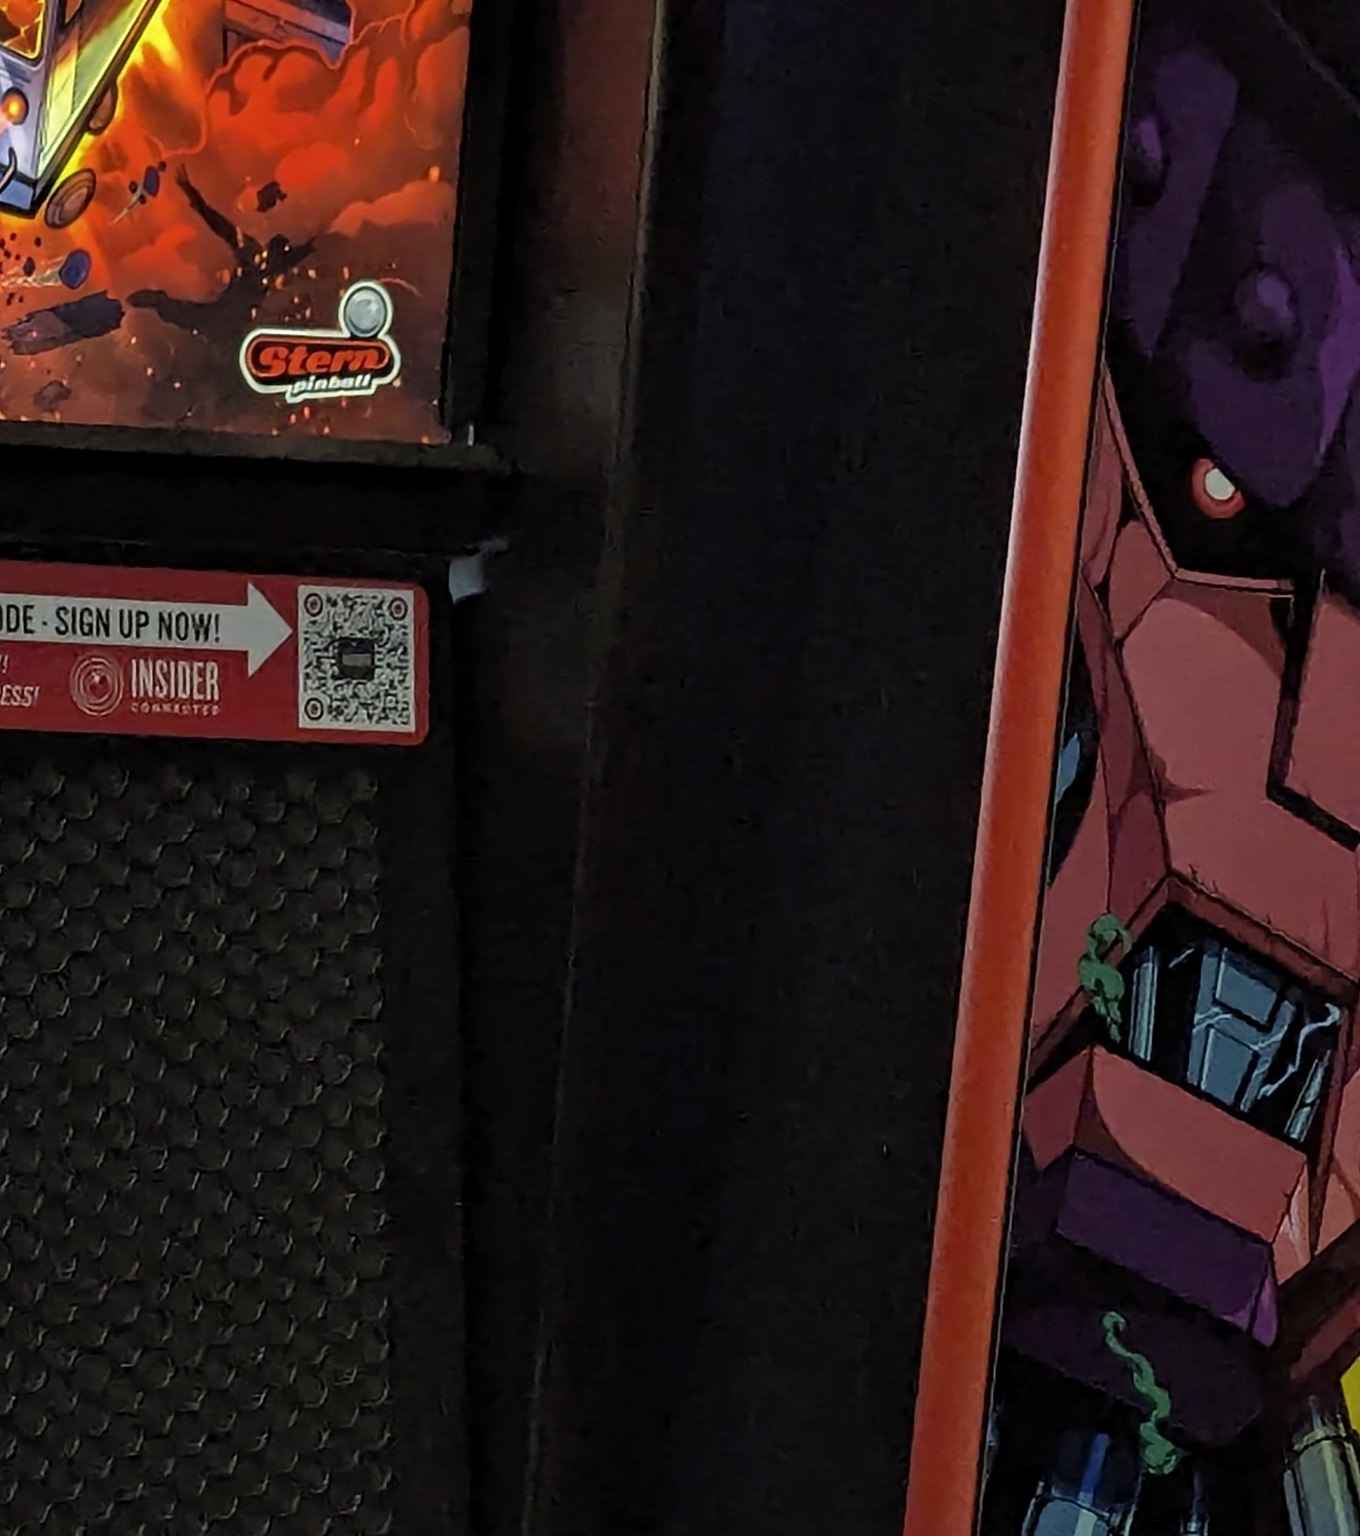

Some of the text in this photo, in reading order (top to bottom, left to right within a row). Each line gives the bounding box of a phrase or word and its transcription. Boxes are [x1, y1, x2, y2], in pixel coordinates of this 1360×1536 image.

[258, 344, 381, 378] Stern
[292, 373, 373, 395] pinball
[54, 606, 112, 639] SIGN
[118, 609, 150, 640] UP
[157, 611, 222, 644] NOW!
[129, 658, 221, 702] INSIDER
